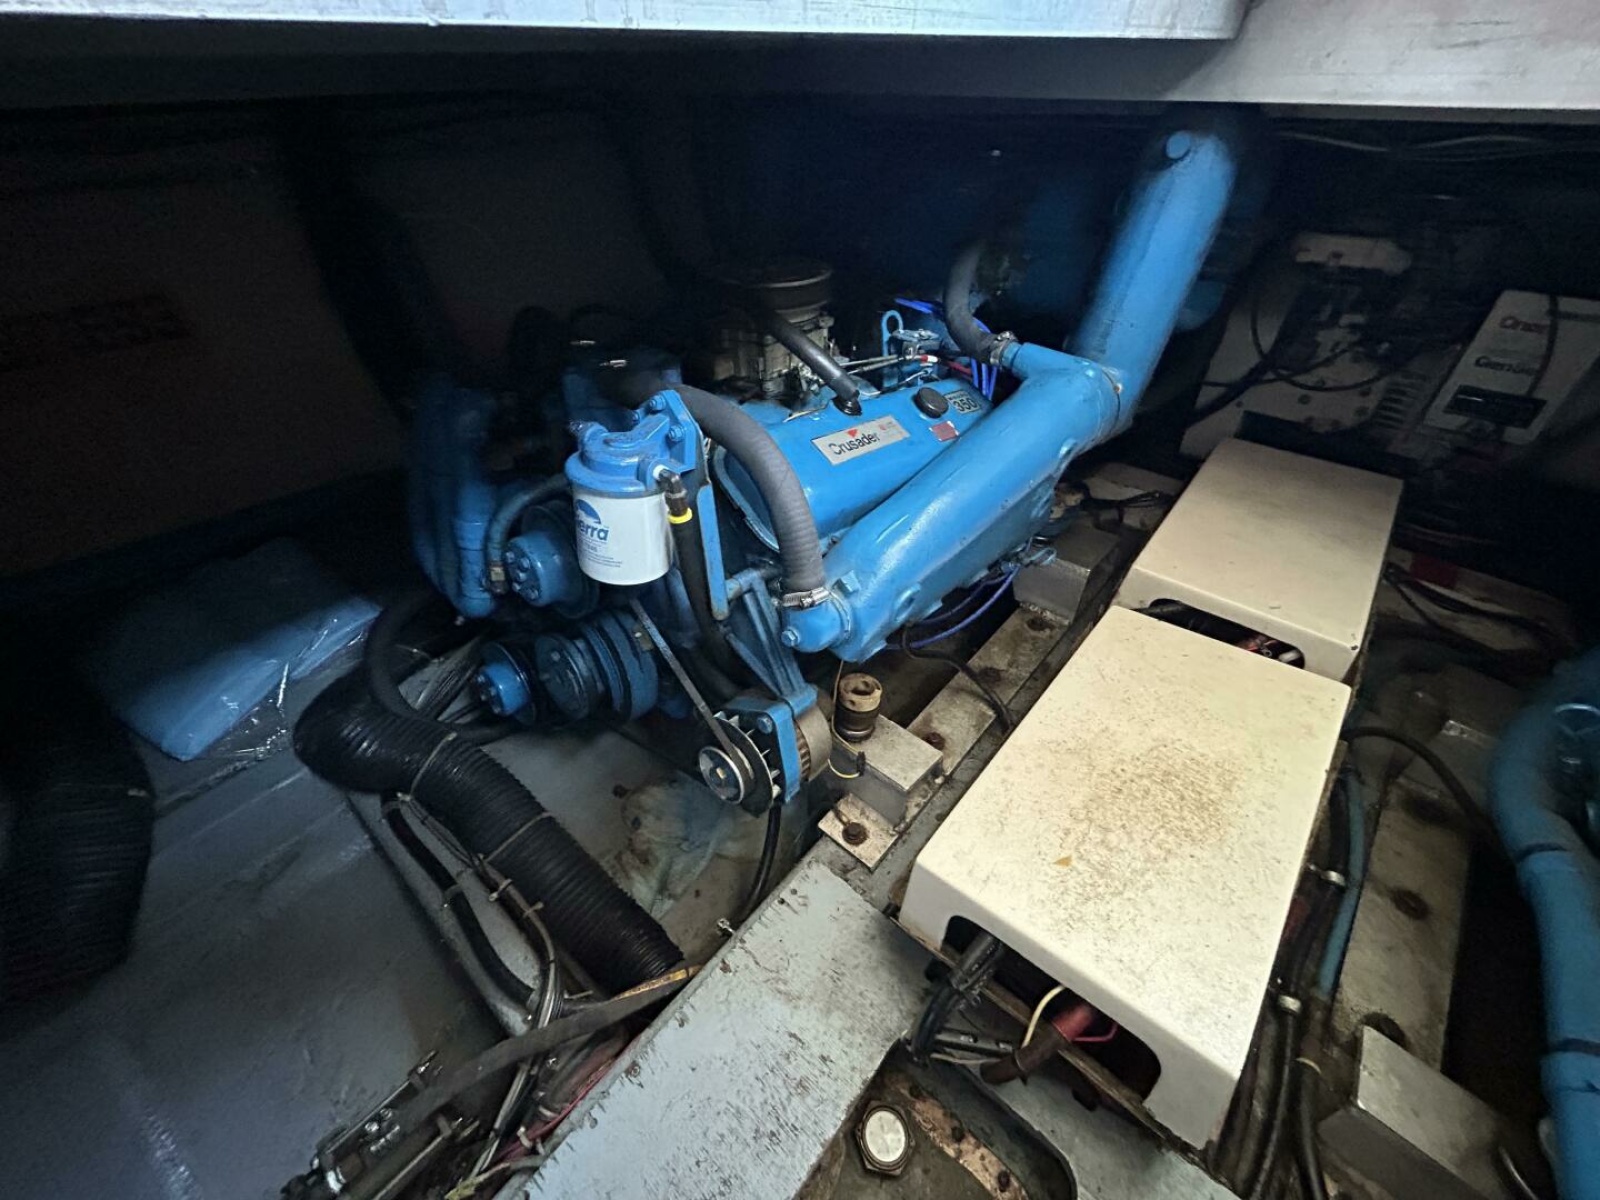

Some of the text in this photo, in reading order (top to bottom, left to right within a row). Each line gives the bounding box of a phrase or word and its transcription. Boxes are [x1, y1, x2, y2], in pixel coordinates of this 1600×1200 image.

[953, 397, 978, 412] 350
[828, 431, 881, 456] Crusader
[577, 519, 609, 540] erra
